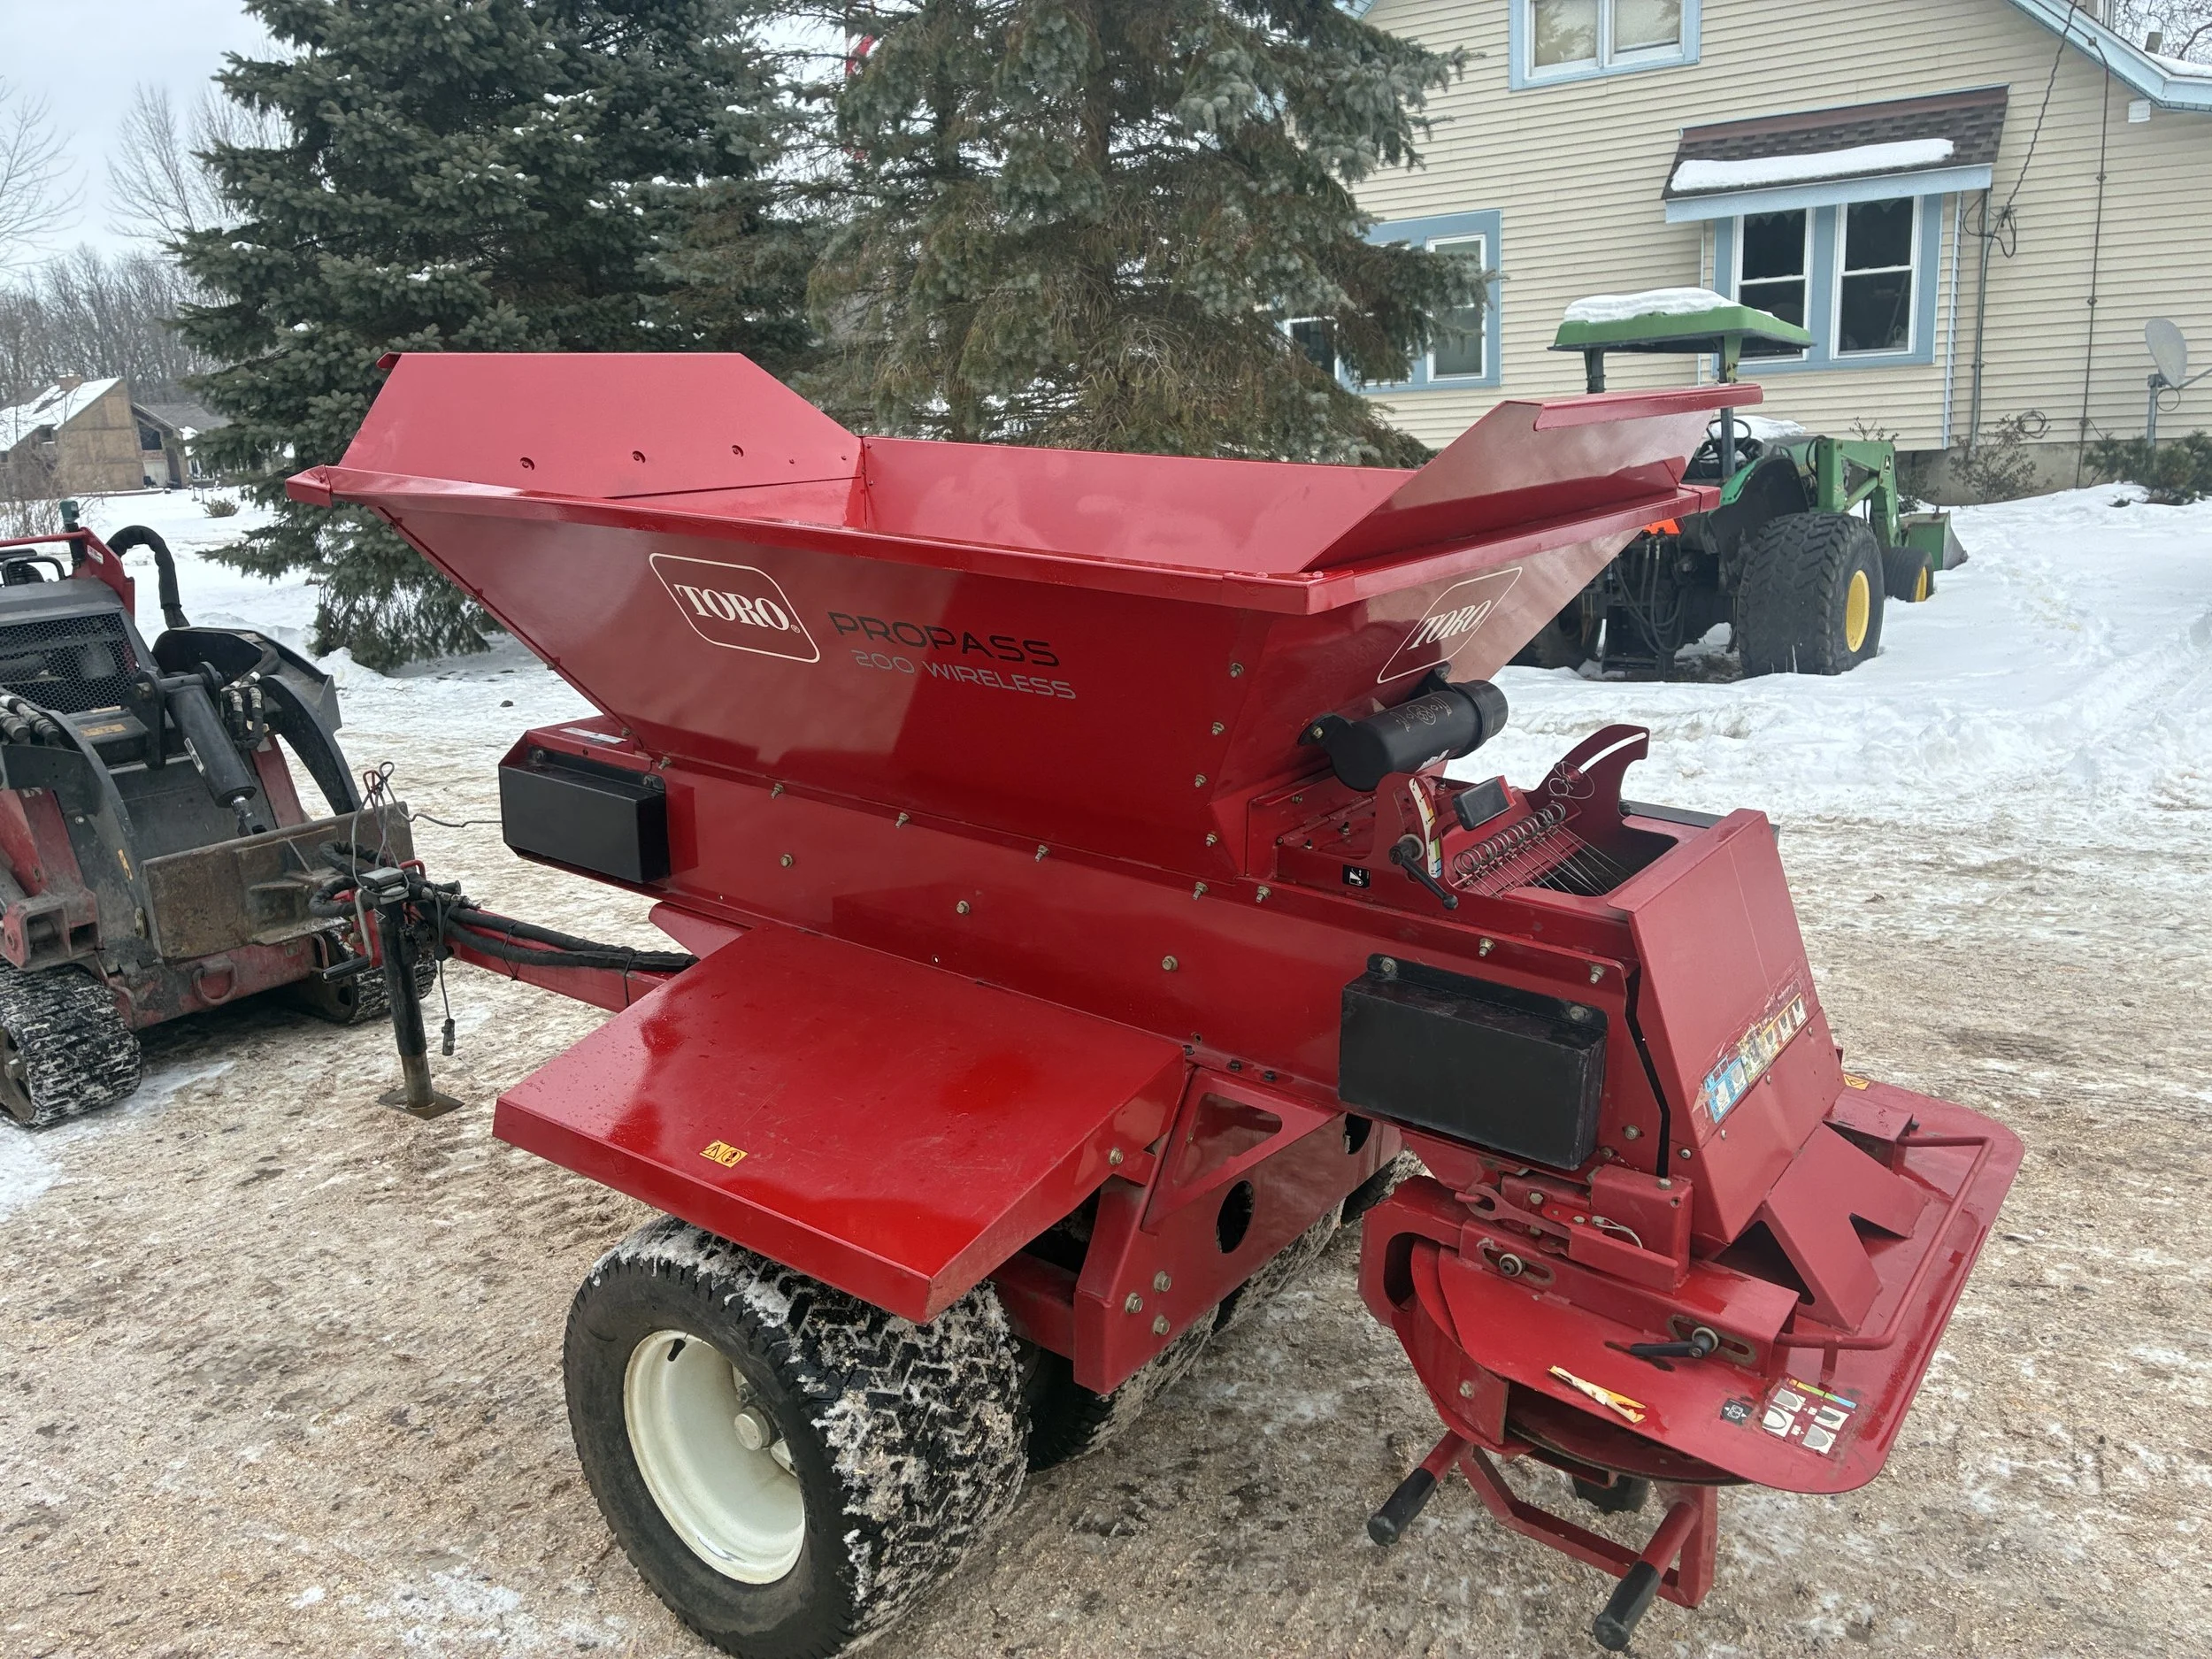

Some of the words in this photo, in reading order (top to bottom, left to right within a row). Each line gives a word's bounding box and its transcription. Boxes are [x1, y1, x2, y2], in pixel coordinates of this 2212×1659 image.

[673, 584, 790, 631] TORO
[1407, 600, 1492, 650] TORO
[827, 611, 1060, 667] PROPASS
[850, 649, 915, 673] 200
[922, 661, 1077, 700] WIRELESS
